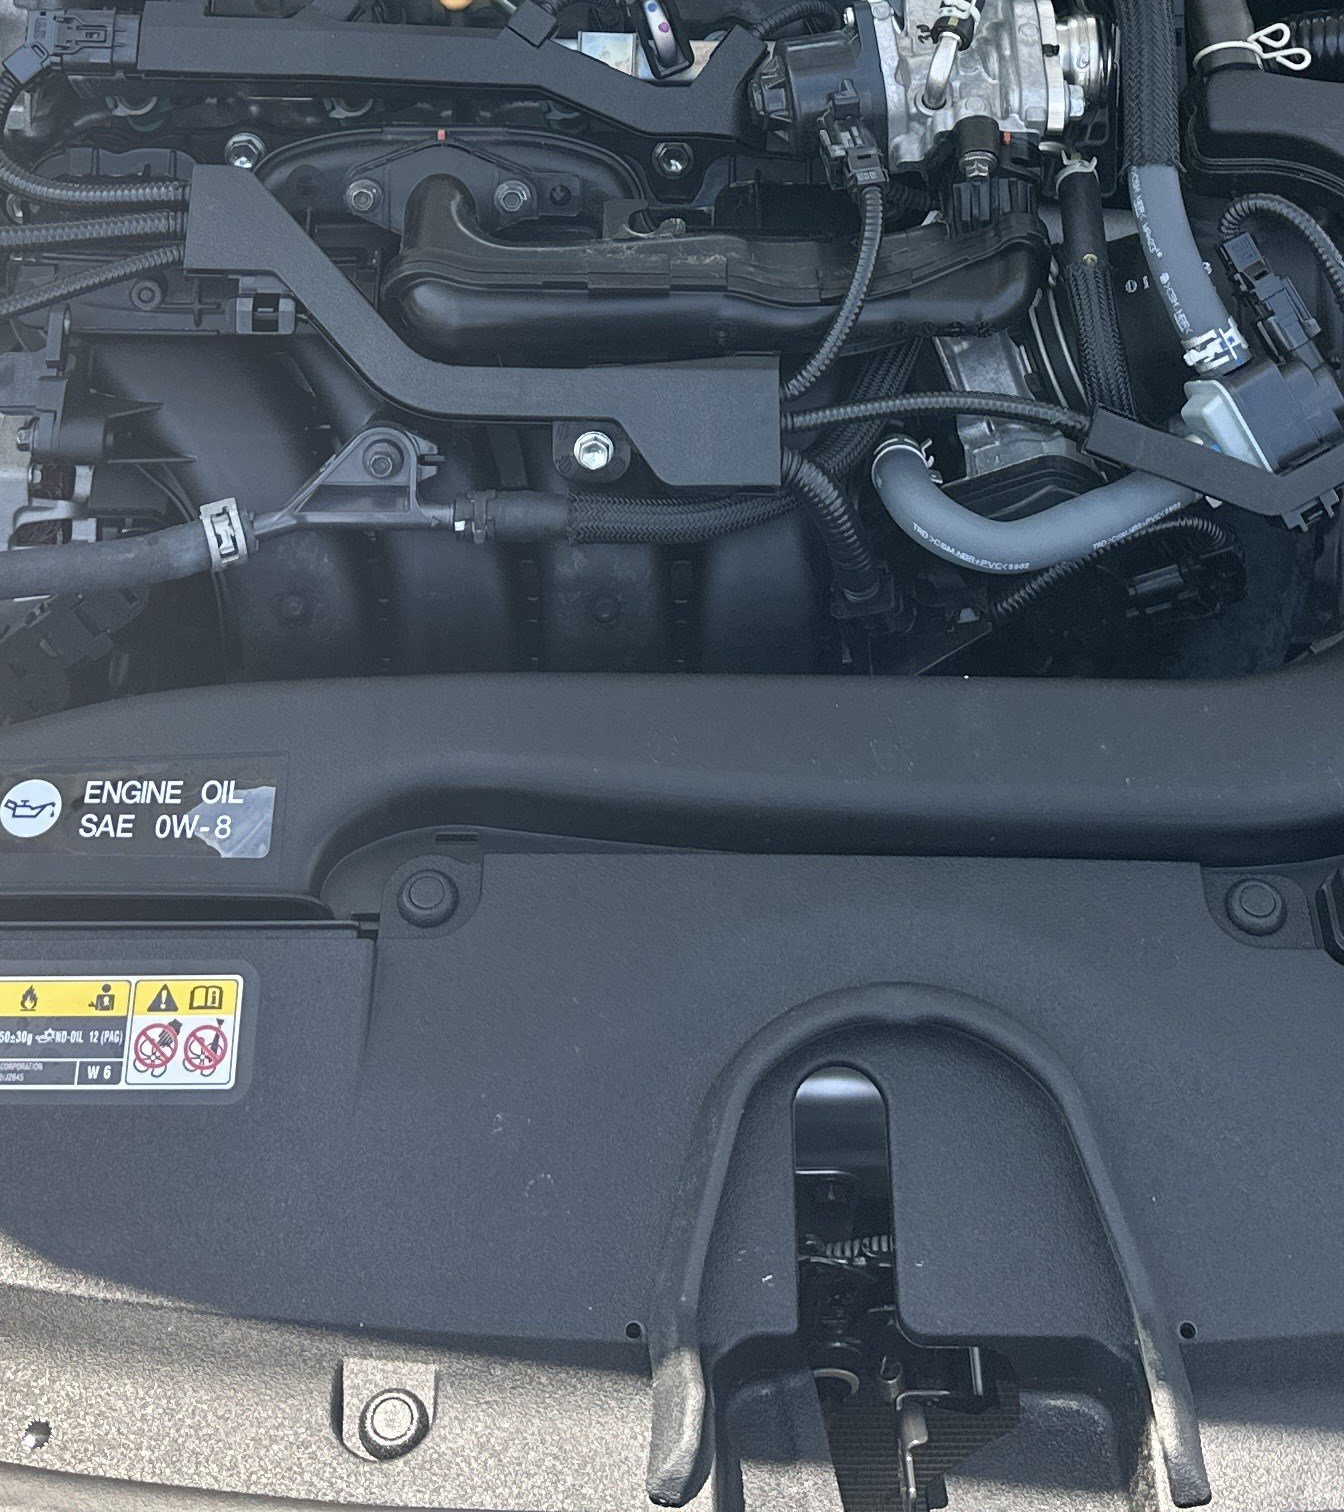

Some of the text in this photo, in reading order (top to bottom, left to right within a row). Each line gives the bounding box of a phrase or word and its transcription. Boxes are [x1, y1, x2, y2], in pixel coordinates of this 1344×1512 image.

[83, 780, 244, 804] ENGINE OIL
[78, 814, 232, 839] SAE 0W-8
[89, 1030, 99, 1043] 12
[87, 1065, 111, 1079] W 6
